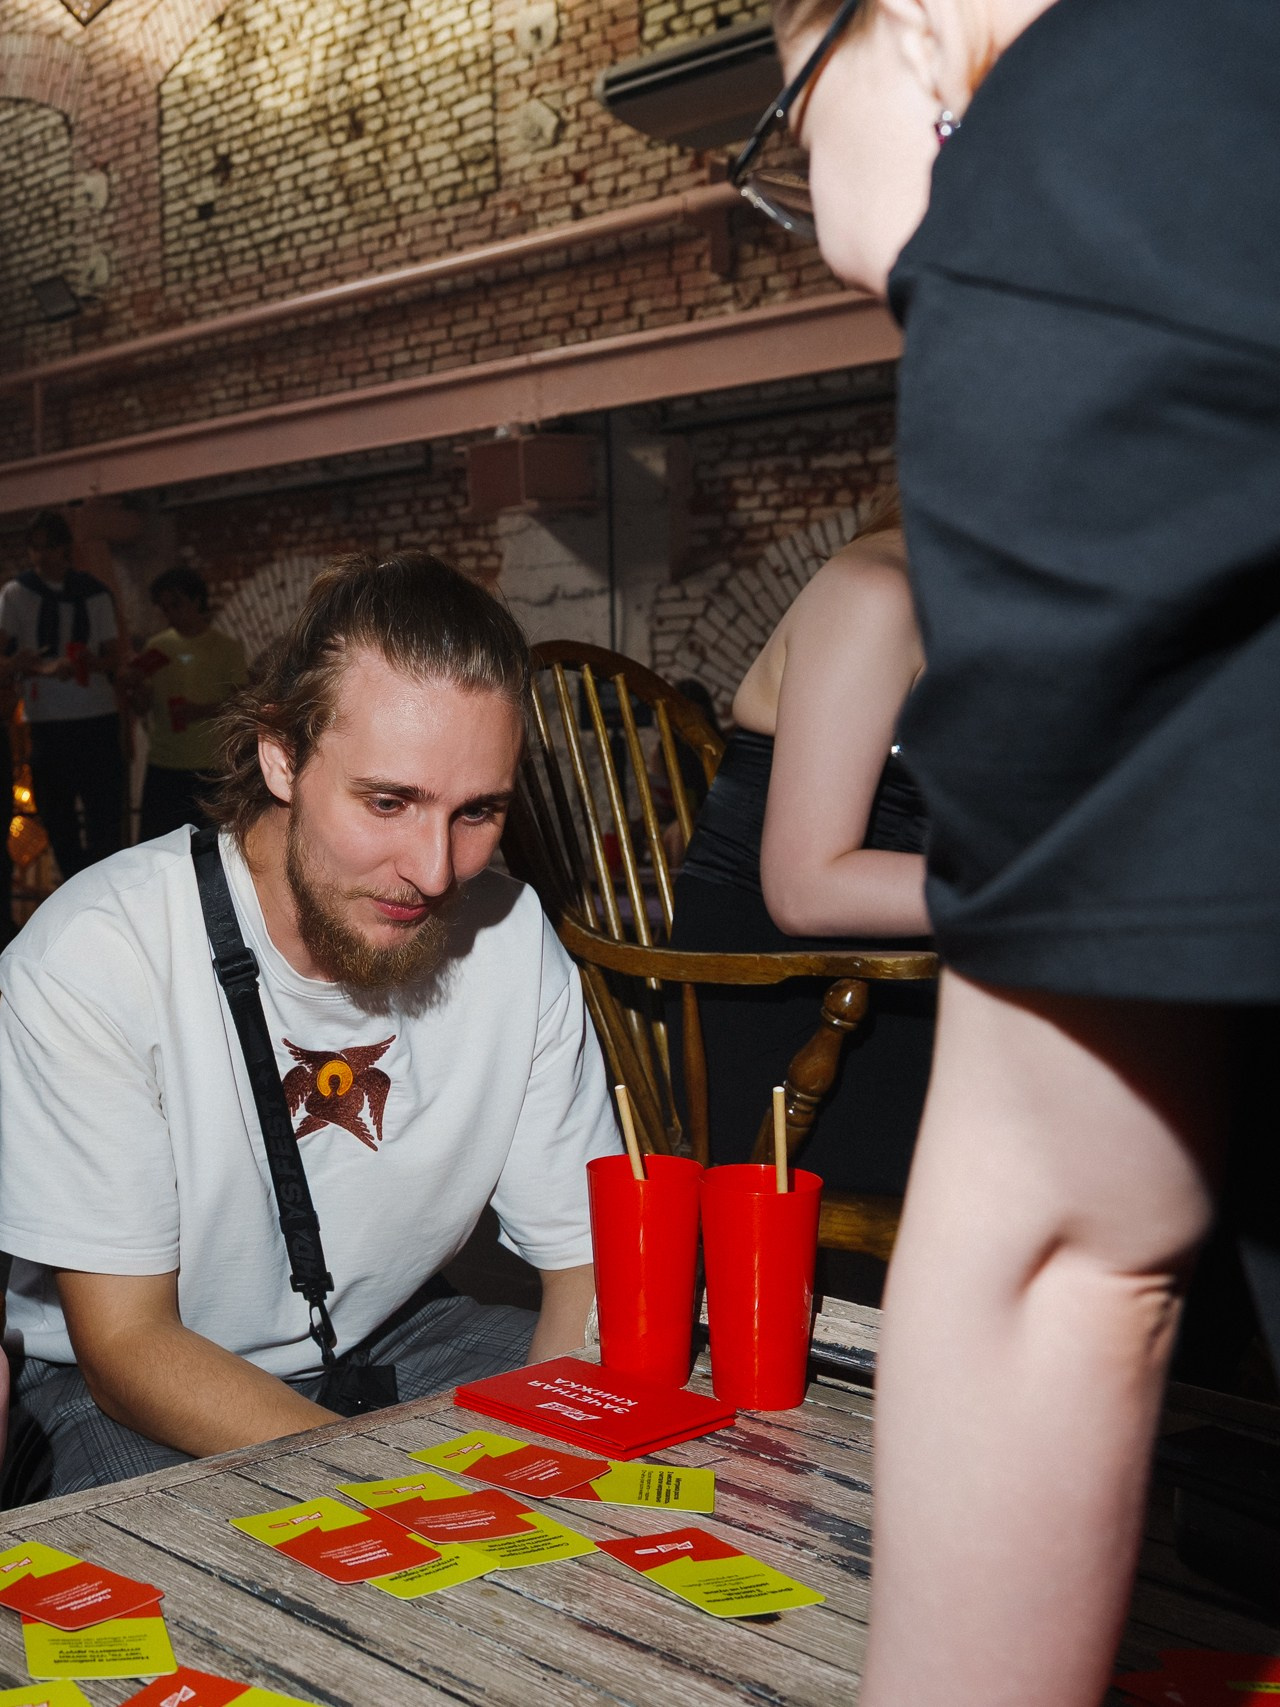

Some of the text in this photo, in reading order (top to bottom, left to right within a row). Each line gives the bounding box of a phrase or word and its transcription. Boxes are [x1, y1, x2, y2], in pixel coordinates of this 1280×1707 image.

[258, 1094, 299, 1179] FEST
[527, 1380, 630, 1414] ЗАЧЕТНАЯ
[554, 1377, 639, 1407] КНИЖКА
